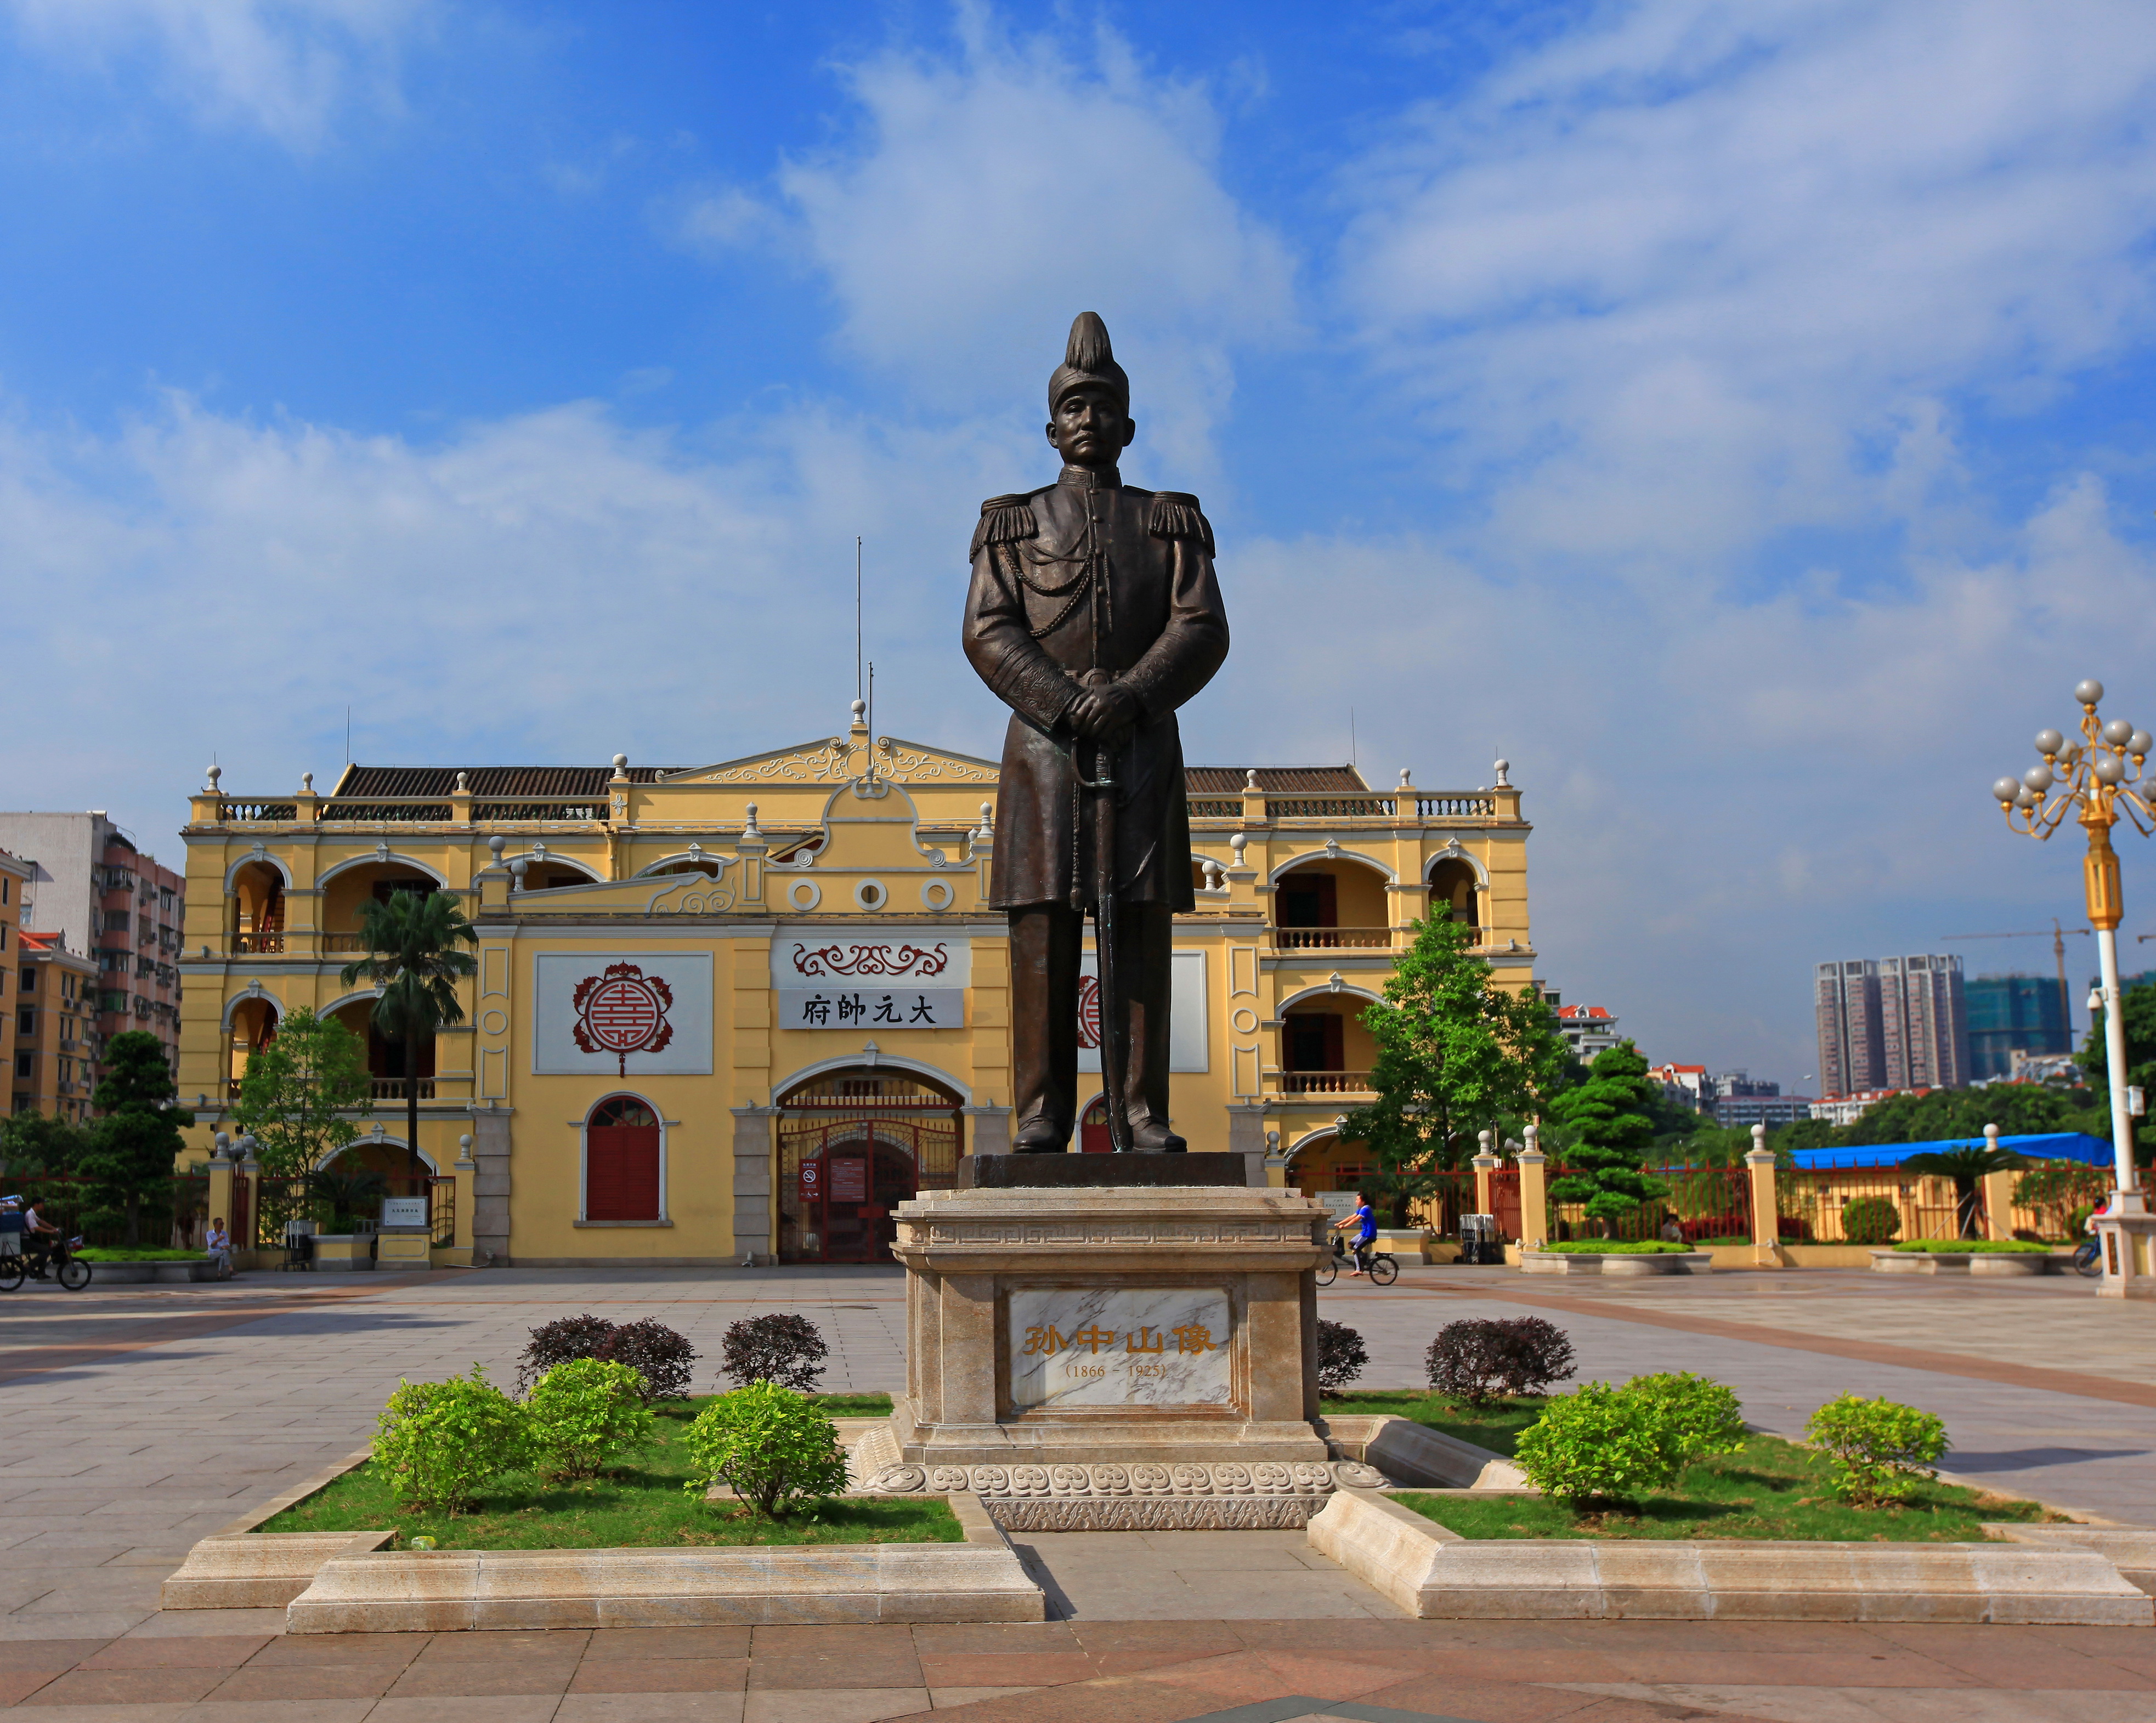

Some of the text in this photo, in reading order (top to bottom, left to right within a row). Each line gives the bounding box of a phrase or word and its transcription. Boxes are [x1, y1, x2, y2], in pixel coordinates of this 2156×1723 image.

[1022, 1324, 1218, 1355] 孙中山像
[1066, 1364, 1106, 1378] (1866
[1129, 1364, 1167, 1377] 1925)
